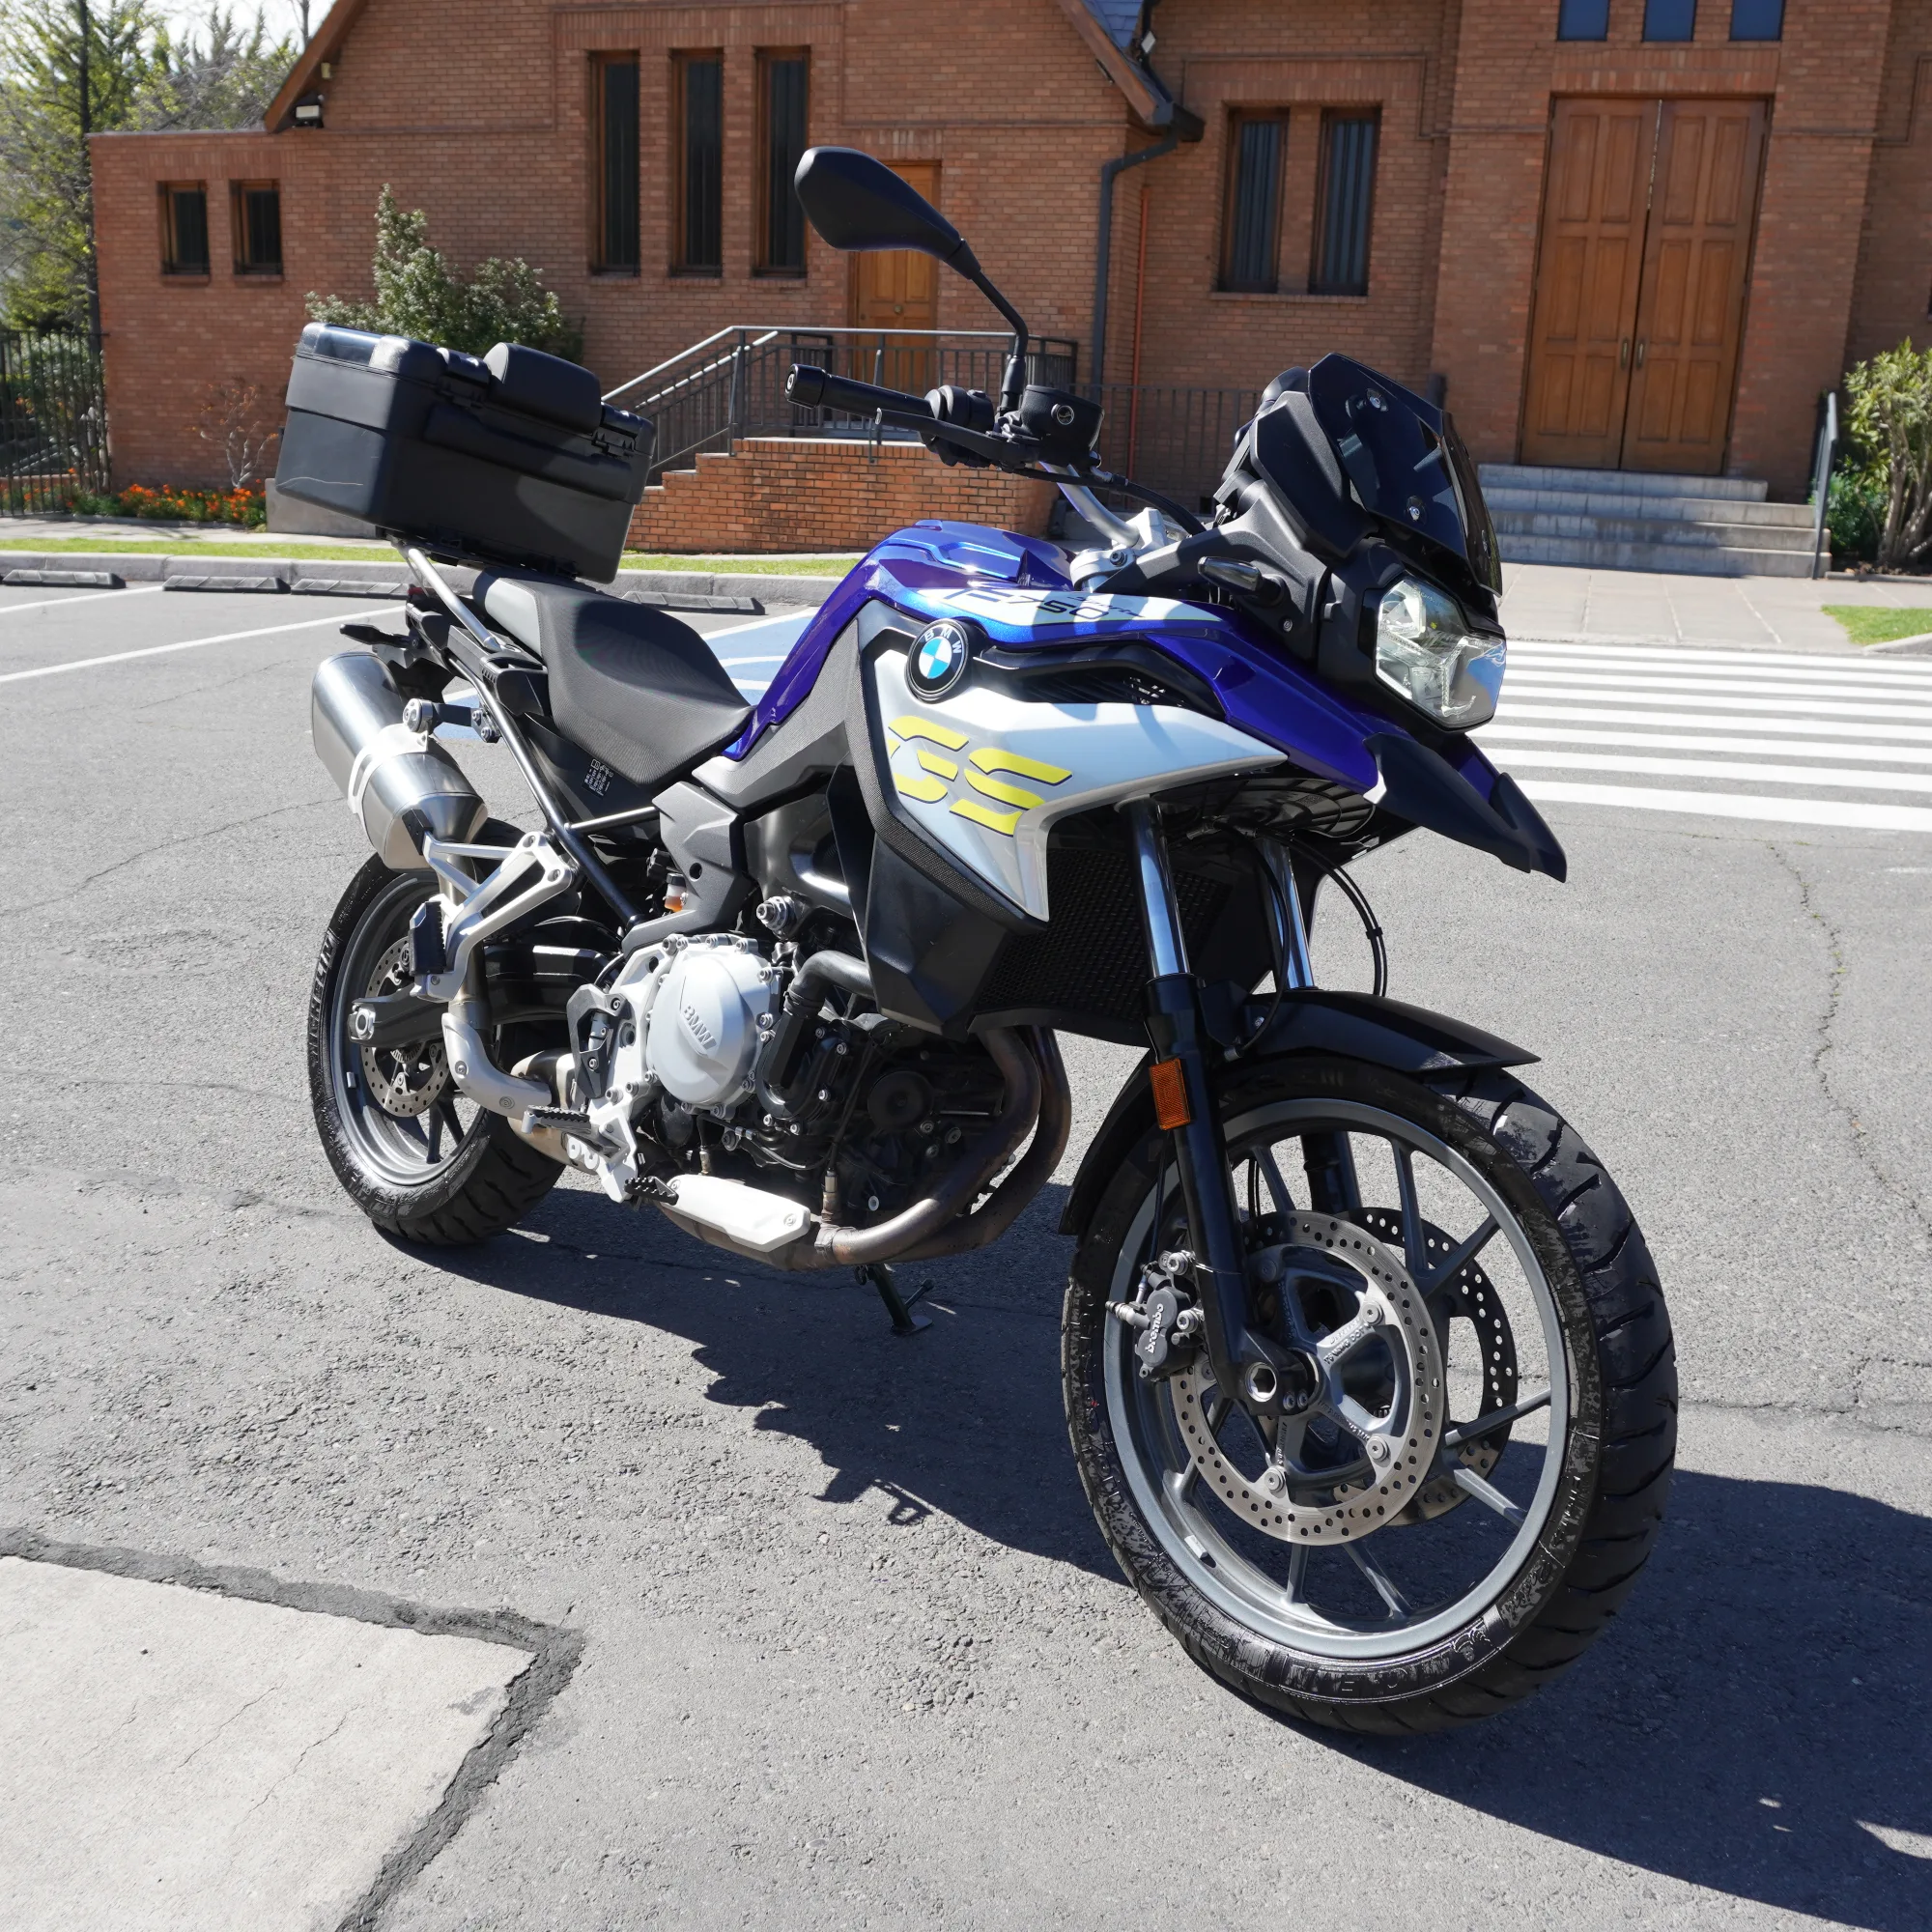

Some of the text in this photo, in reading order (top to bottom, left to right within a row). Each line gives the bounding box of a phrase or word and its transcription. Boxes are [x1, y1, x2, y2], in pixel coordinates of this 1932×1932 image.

[924, 627, 962, 654] BMW
[887, 715, 1072, 837] GS
[684, 1005, 718, 1050] BMW
[1145, 1303, 1164, 1353] brembo
